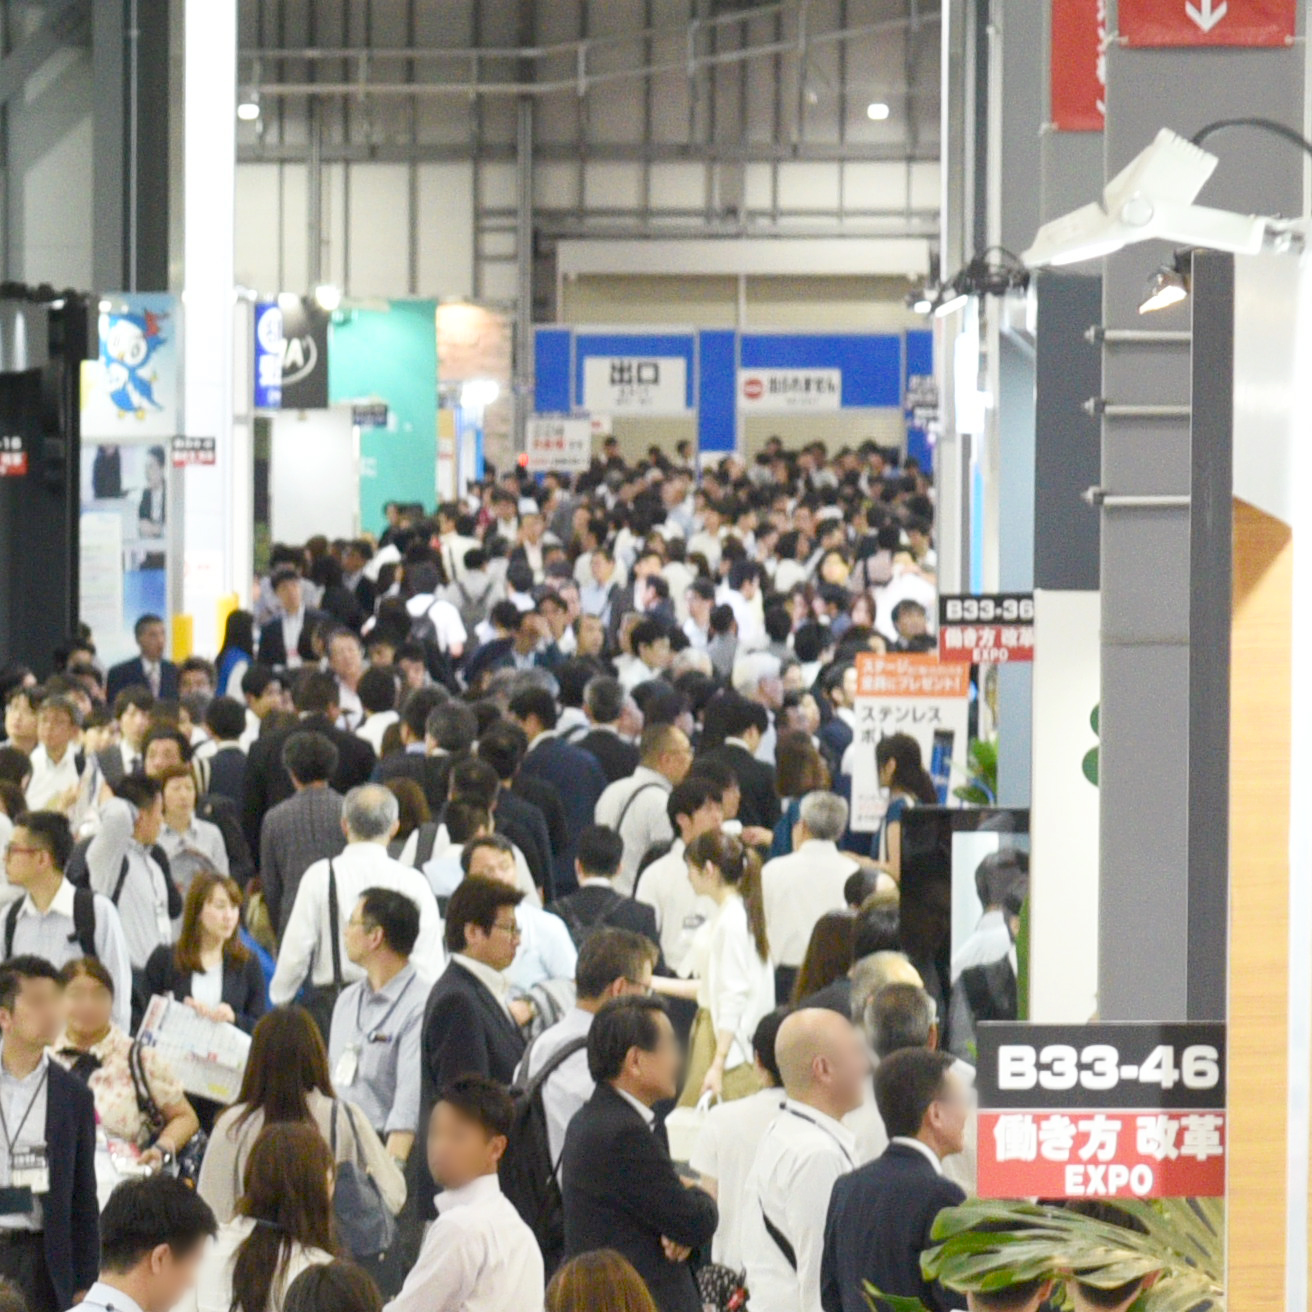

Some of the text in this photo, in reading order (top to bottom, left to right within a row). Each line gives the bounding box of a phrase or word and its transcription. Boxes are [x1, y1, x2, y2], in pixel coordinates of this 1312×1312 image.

[610, 362, 660, 385] 出口
[946, 597, 1035, 620] B33-36
[971, 648, 1009, 662] EXPO
[861, 704, 942, 724] ステンレス
[998, 1044, 1220, 1090] B33-46
[993, 1114, 1224, 1162] 働き方 改革
[1064, 1164, 1154, 1196] EXPO
